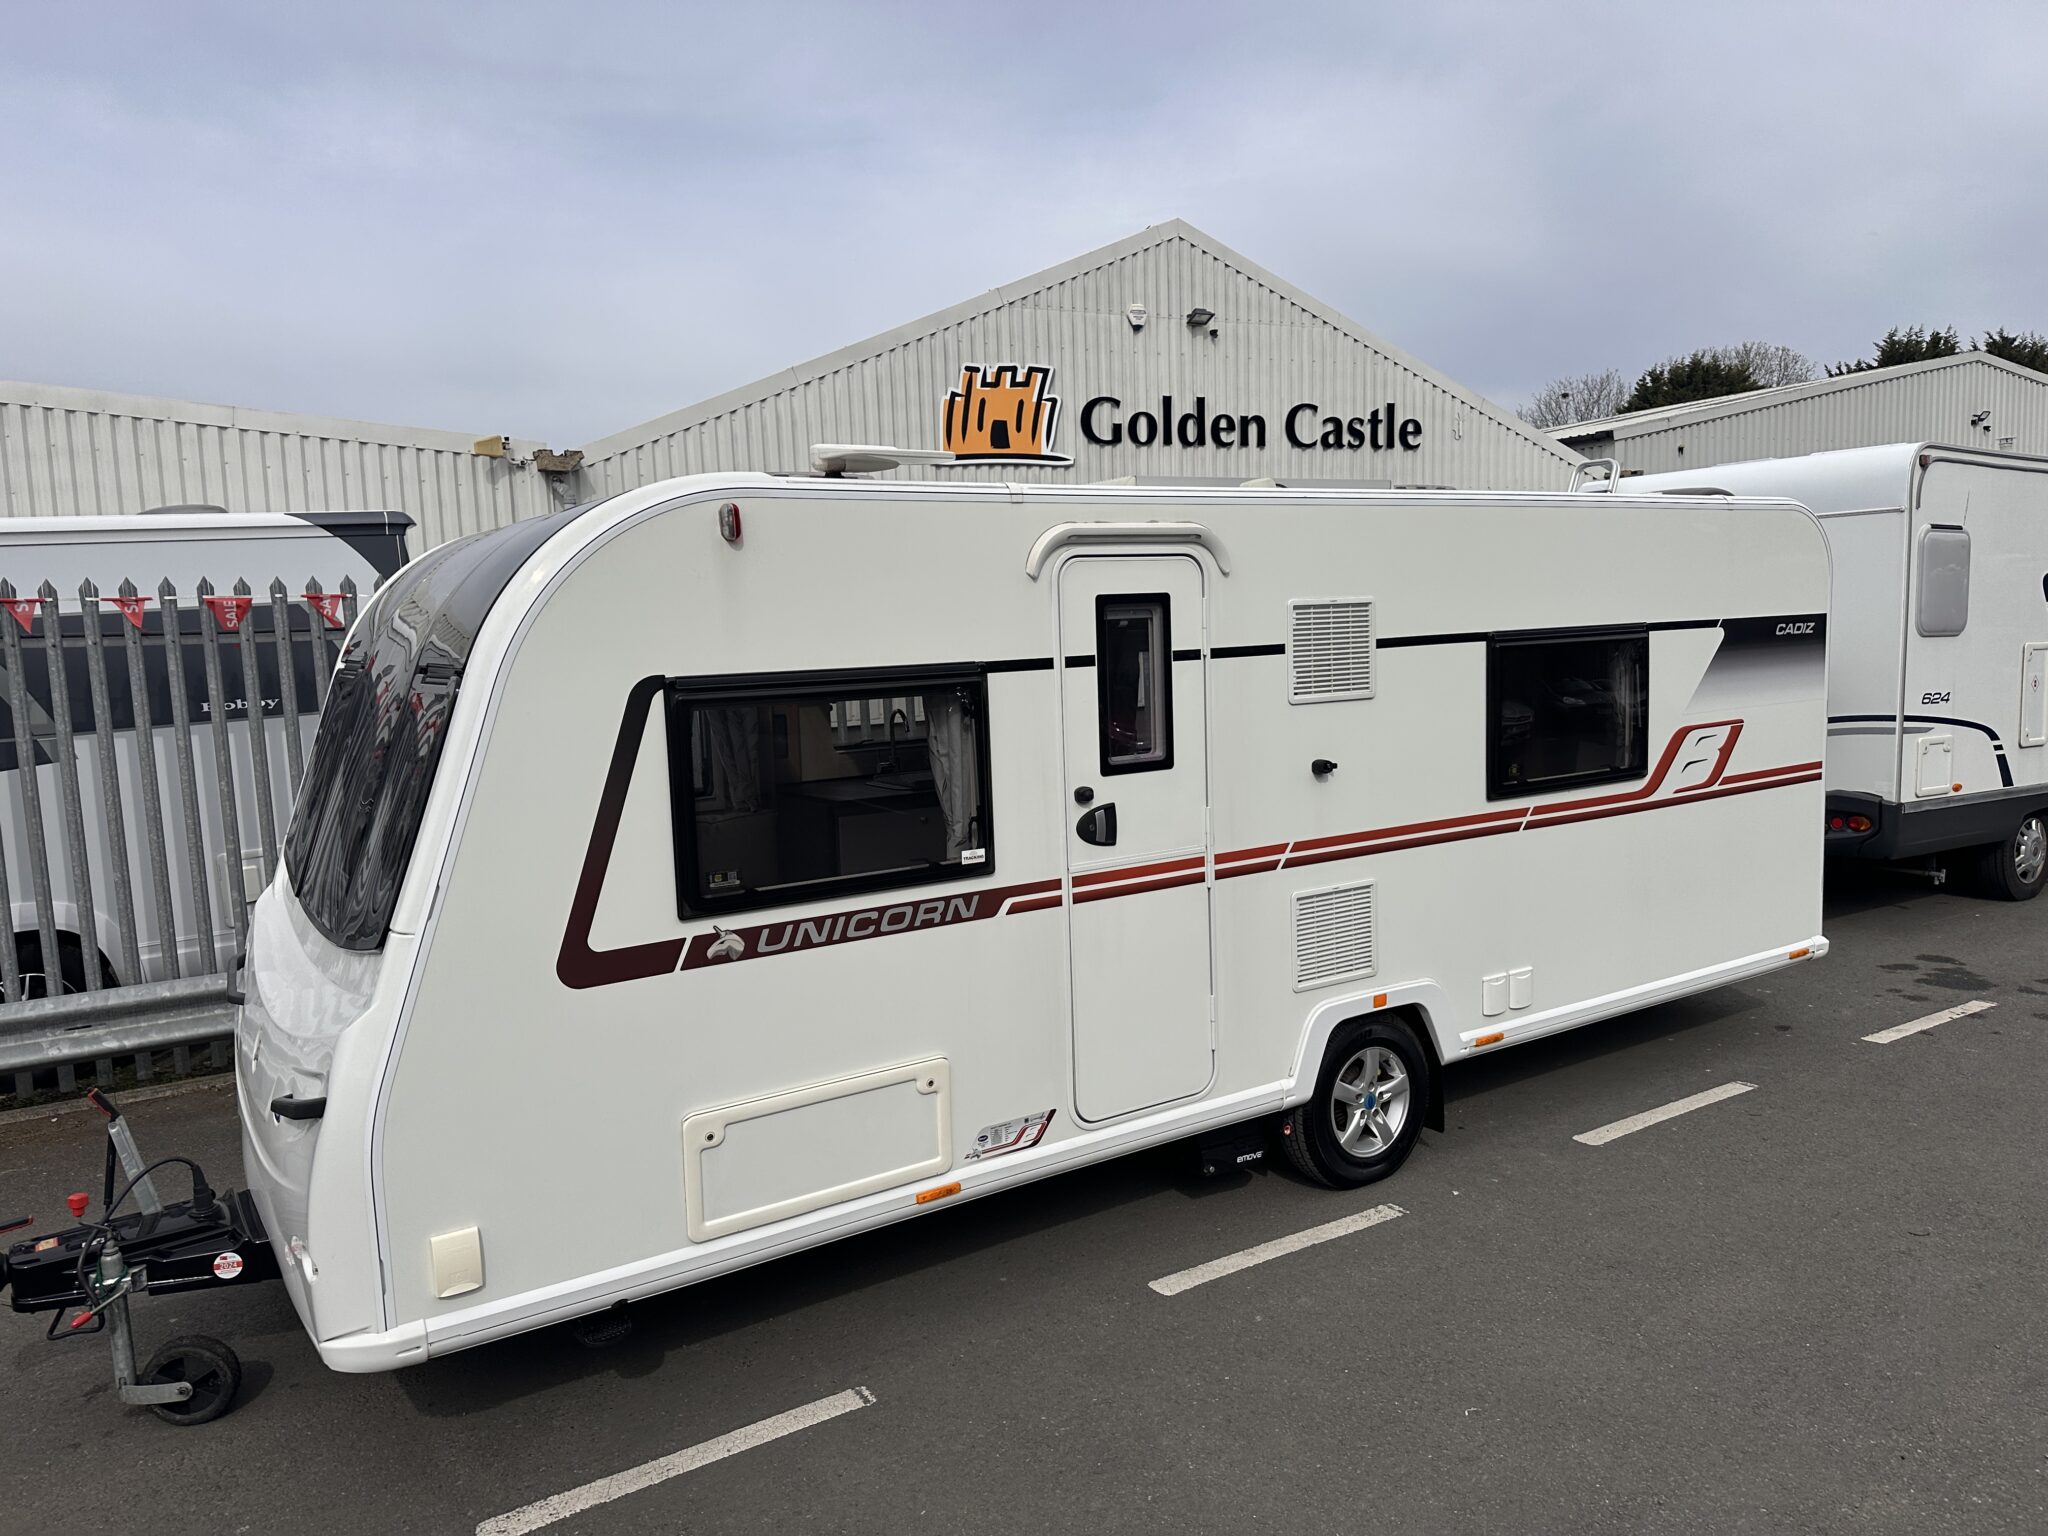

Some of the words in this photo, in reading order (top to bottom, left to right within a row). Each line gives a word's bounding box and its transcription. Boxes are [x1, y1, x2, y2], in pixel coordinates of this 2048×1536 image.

[1080, 395, 1266, 448] Golden
[1285, 402, 1423, 450] Castle
[223, 600, 239, 627] SALE
[1775, 622, 1816, 635] CADIZ
[1921, 691, 1951, 704] 624
[757, 895, 979, 953] UNICORN
[219, 1261, 238, 1270] 2024
